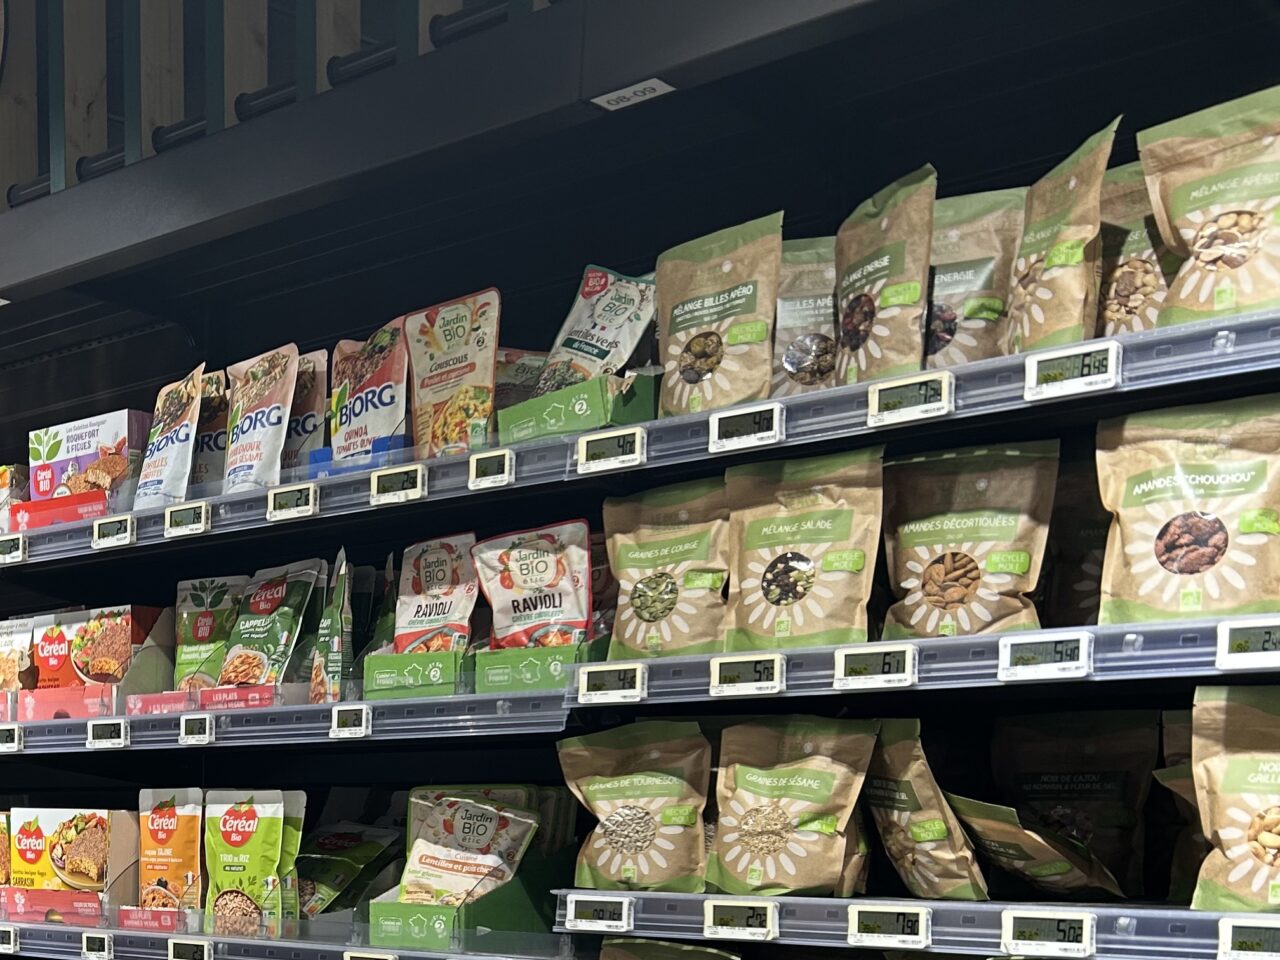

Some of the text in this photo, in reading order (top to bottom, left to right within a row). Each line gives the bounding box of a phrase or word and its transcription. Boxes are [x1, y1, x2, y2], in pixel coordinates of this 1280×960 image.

[1190, 177, 1240, 200] MÉLANGE
[672, 299, 703, 317] MÉLANGE
[729, 283, 754, 301] APÉRO
[816, 296, 834, 307] APÉ
[440, 312, 467, 329] Jardin
[429, 353, 469, 373] Couscous
[66, 429, 99, 444] ROQUEFORT
[345, 425, 368, 441] QUINOA
[71, 441, 92, 453] FIGUES
[1133, 476, 1179, 495] AMANDES
[761, 519, 832, 536] MÉLANGE SALADE
[903, 515, 1015, 533] AMANDES DÉCORTIQUÉES
[515, 548, 549, 563] Jardin
[628, 540, 698, 559] GRAINES DE COURGE
[422, 556, 448, 570] Jardin
[250, 582, 287, 604] Céréal
[413, 601, 452, 619] RAVIOLI
[511, 593, 562, 614] RAVIOLI
[38, 641, 68, 657] Céréal
[589, 775, 681, 792] GRAINES DE TOURNESOL
[745, 773, 821, 790] GRAINES DE SÉSAME
[148, 813, 177, 830] Céréal
[219, 813, 257, 832] Céréal
[460, 808, 493, 825] Jardin
[15, 834, 45, 851] Céréal
[157, 831, 167, 840] Bio
[231, 832, 242, 842] Bio
[220, 854, 233, 862] TRIO
[239, 854, 249, 863] RIZ
[420, 856, 453, 870] Lentilles
[454, 862, 461, 870] et
[12, 875, 35, 887] SARRASIN
